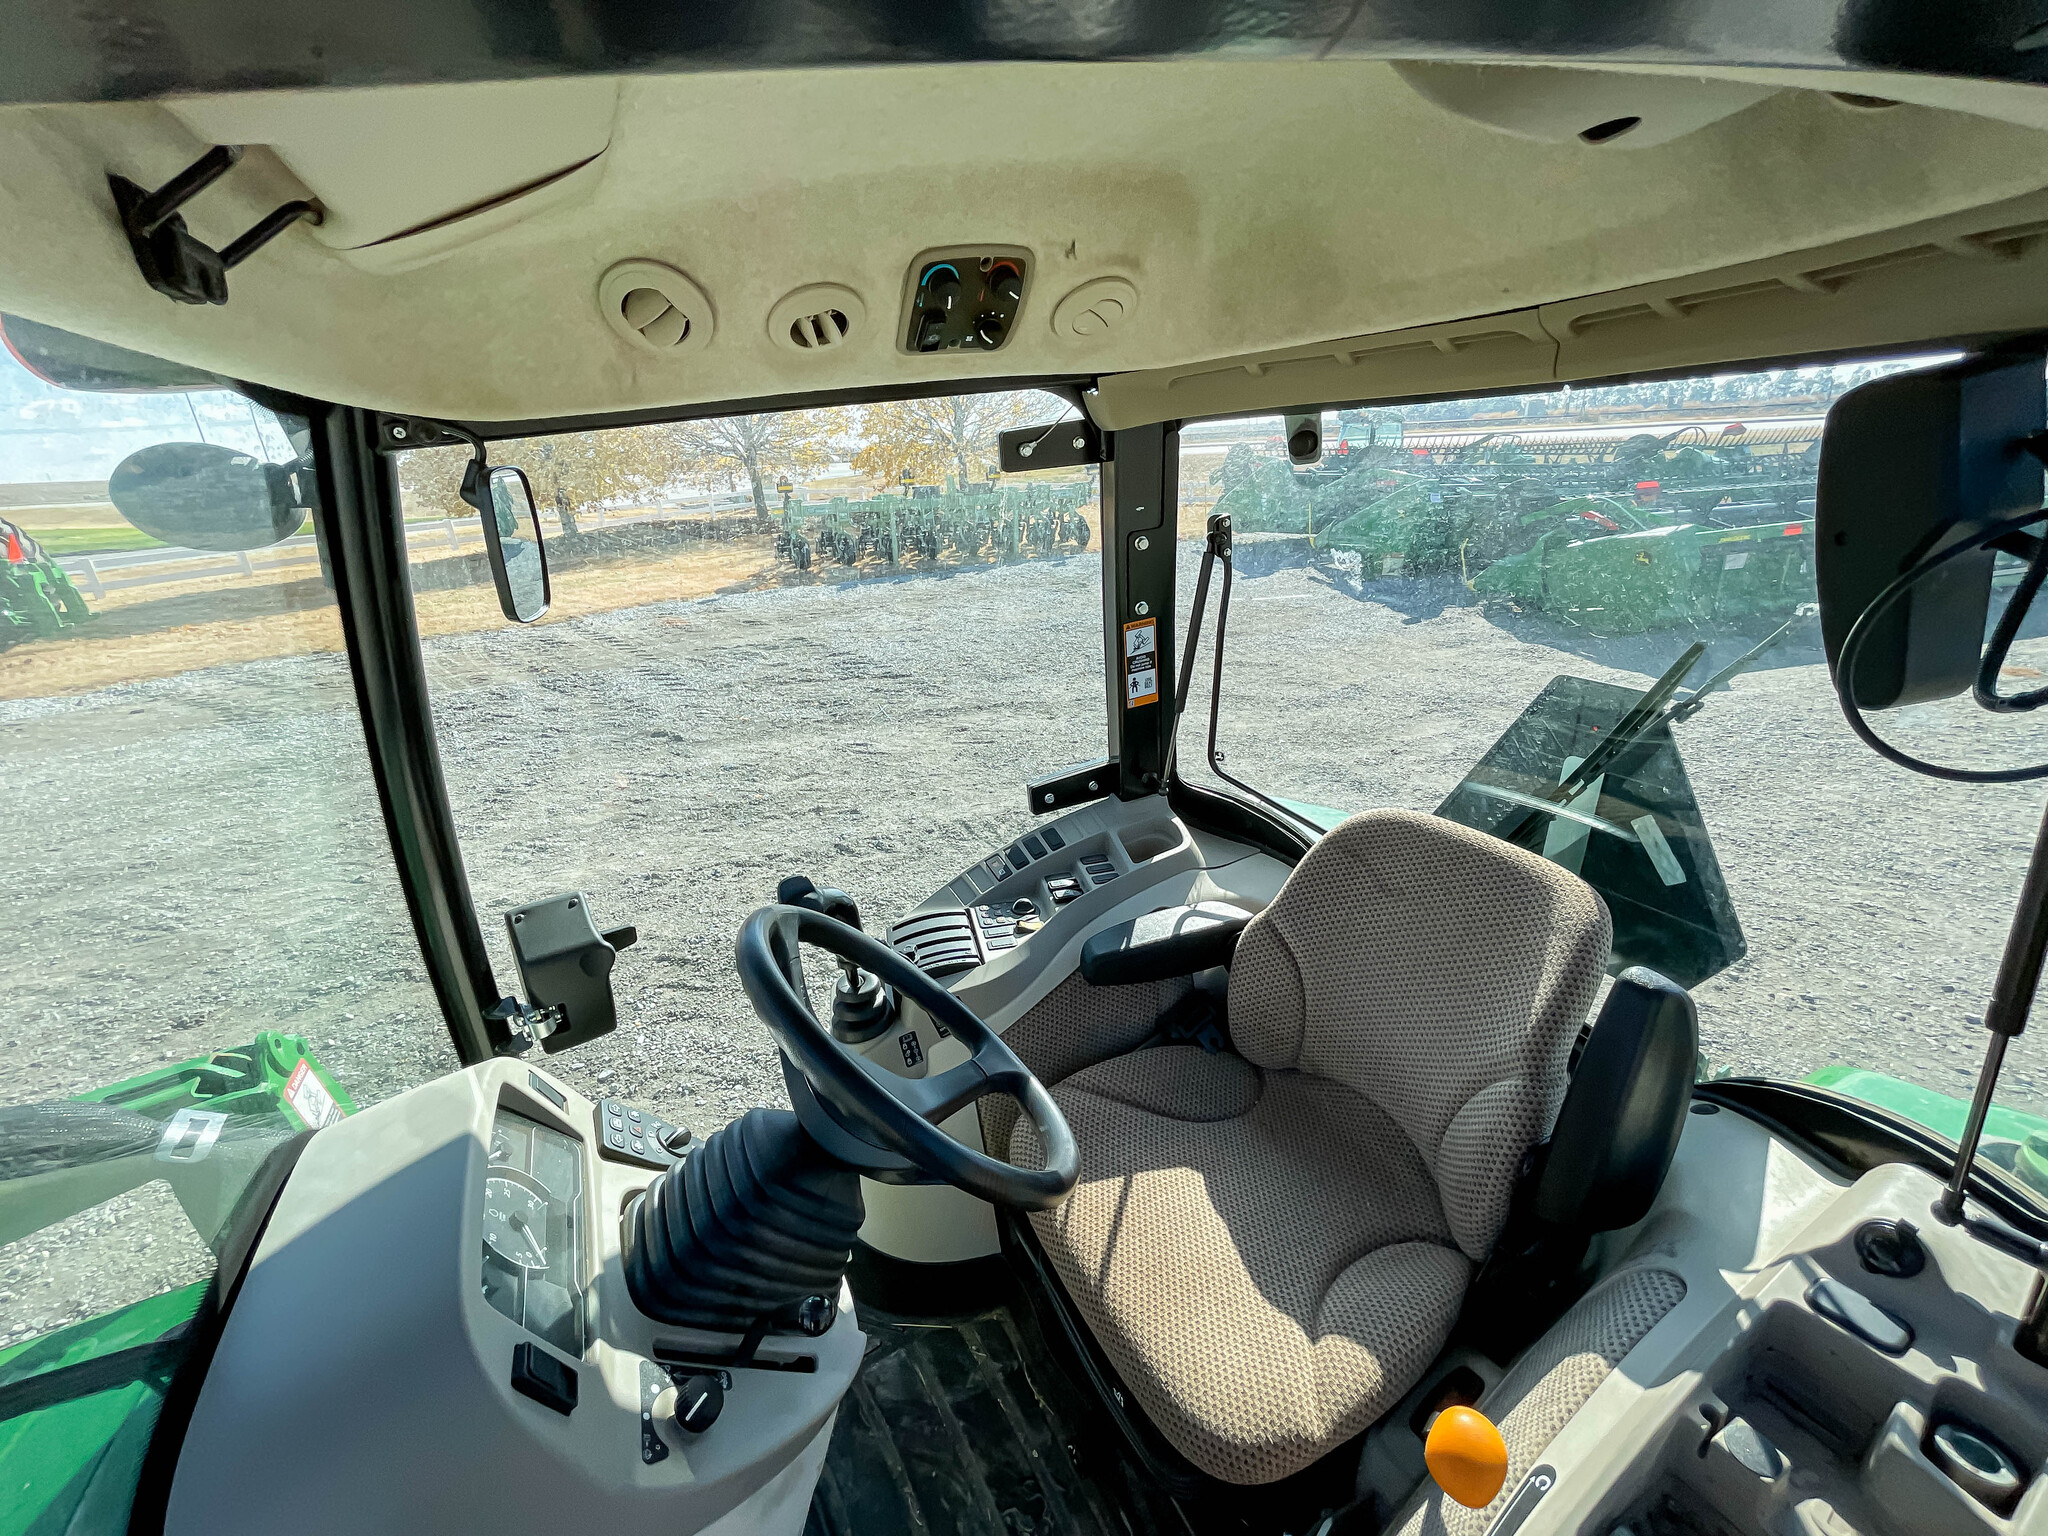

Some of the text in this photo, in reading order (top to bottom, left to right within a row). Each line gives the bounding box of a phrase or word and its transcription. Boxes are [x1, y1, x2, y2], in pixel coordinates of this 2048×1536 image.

[292, 1063, 308, 1090] DANGER
[504, 1188, 511, 1198] 25
[527, 1200, 534, 1210] 30
[489, 1232, 497, 1242] 10
